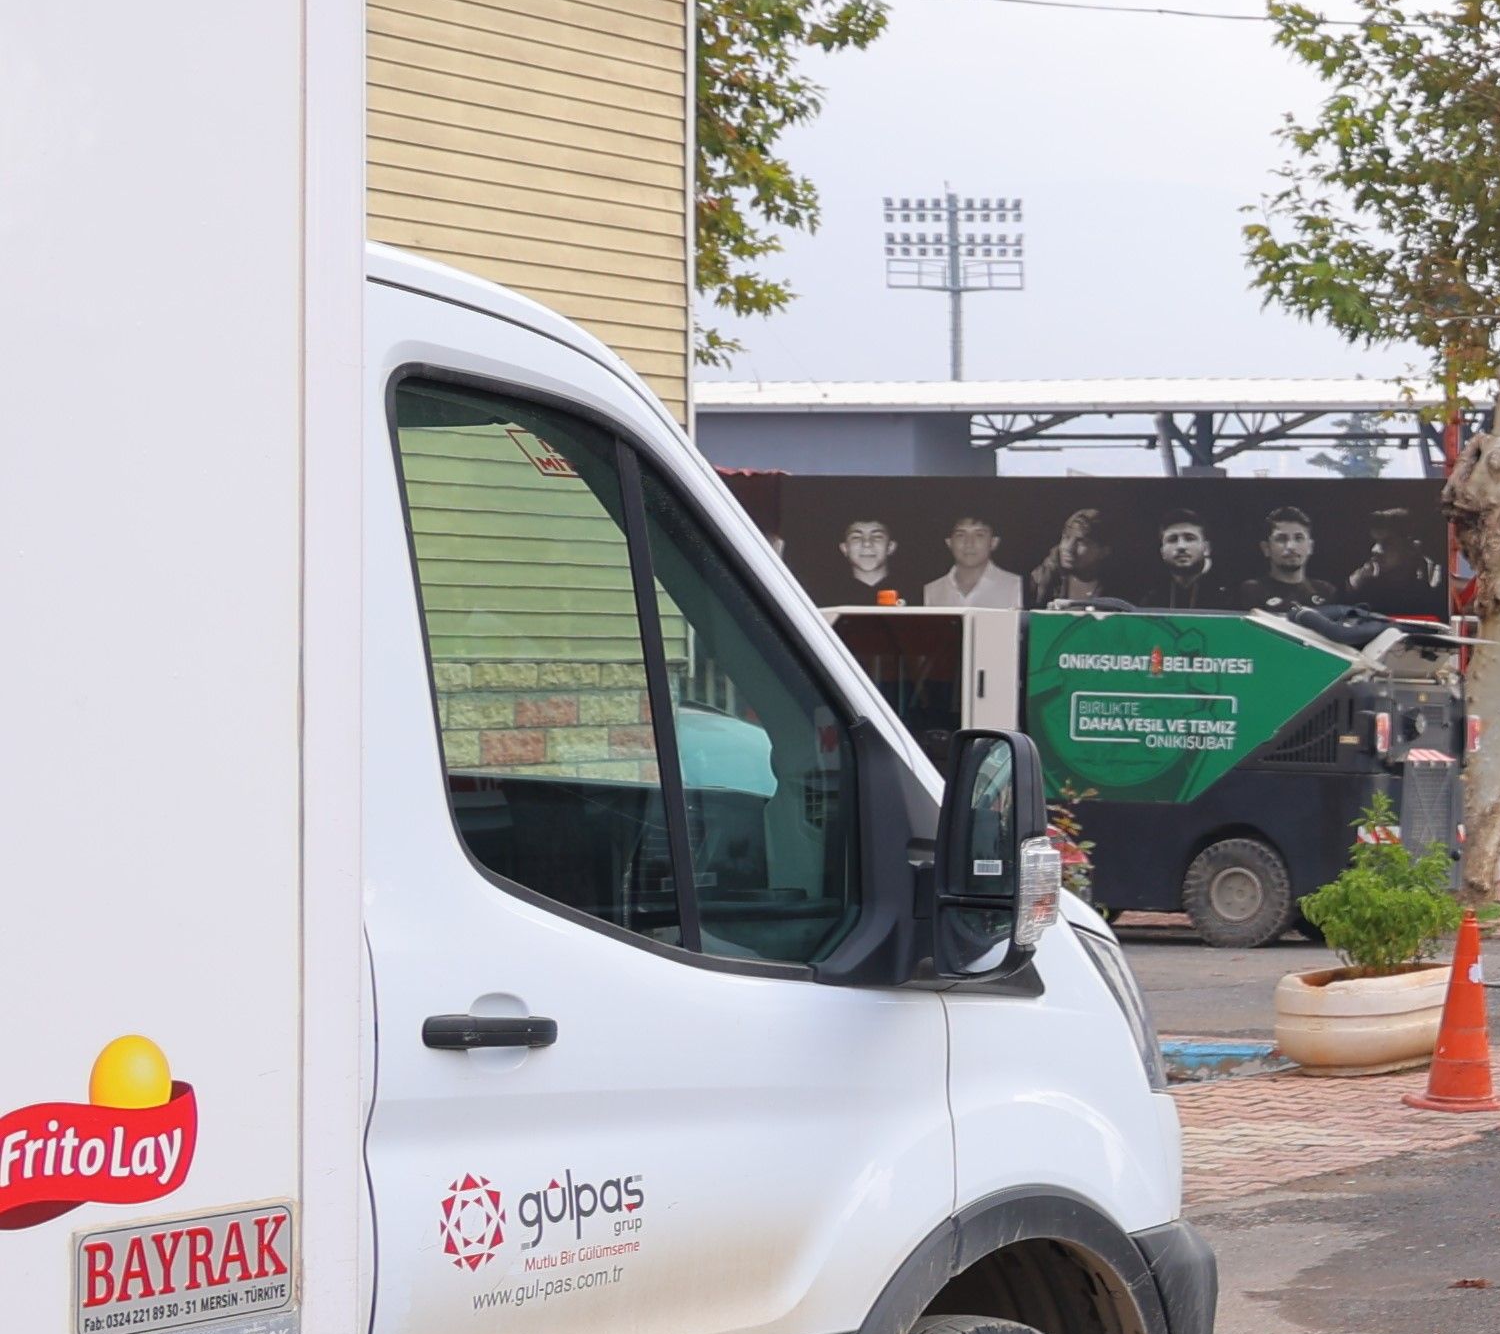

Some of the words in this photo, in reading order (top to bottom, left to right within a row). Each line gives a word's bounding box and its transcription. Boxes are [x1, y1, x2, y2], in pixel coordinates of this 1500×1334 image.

[1079, 717, 1125, 731] DAHA
[1166, 720, 1186, 733] VE
[614, 1217, 642, 1236] grup
[83, 1214, 288, 1308] BAYRAK
[524, 1254, 557, 1272] Mutlu
[560, 1250, 575, 1266] Bir
[578, 1240, 640, 1263] Gülümseme
[473, 1265, 623, 1310] www.gul-pas.com.tr
[84, 1317, 105, 1333] Fab:
[106, 1312, 130, 1328] 0324
[133, 1308, 150, 1324] 221
[152, 1306, 165, 1321] 89
[200, 1291, 238, 1312] MERSİN
[245, 1282, 286, 1303] TÜRKİYE
